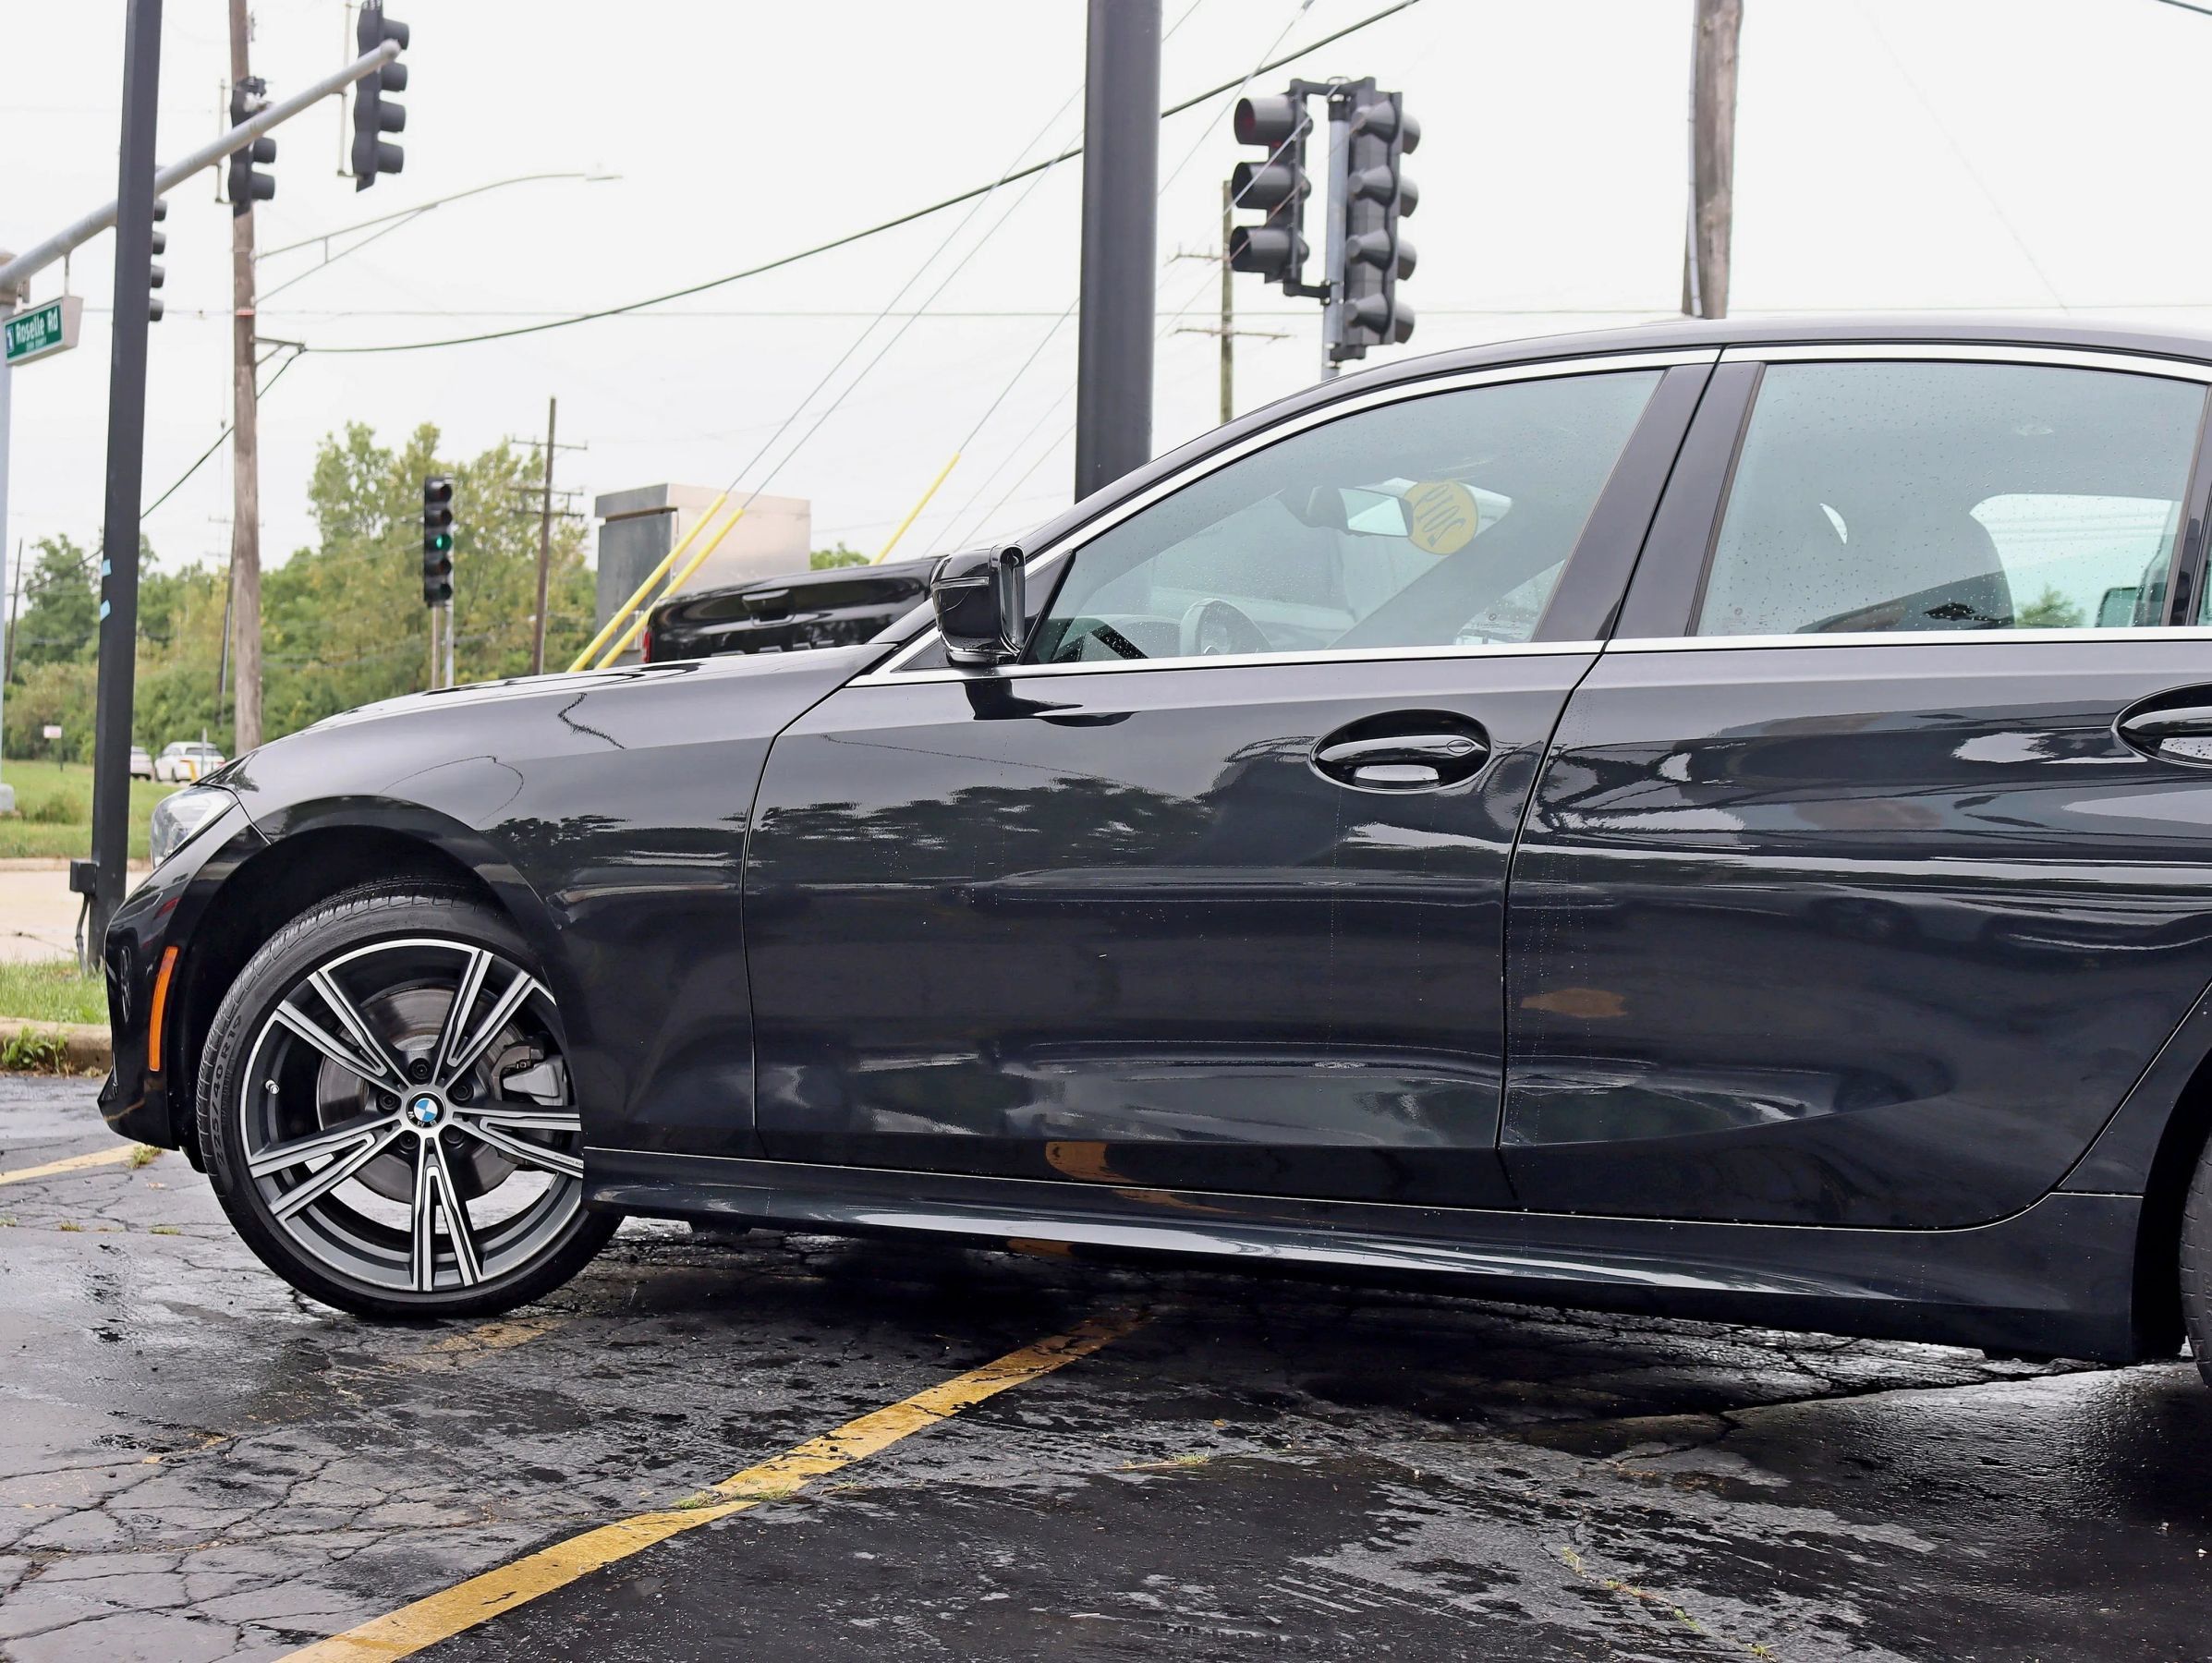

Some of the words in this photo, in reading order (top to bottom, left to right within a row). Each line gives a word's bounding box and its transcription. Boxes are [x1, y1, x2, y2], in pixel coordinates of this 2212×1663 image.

[16, 313, 44, 345] Roselle
[47, 306, 58, 333] Rd
[213, 1064, 225, 1166] 225/40
[221, 1014, 241, 1060] R19
